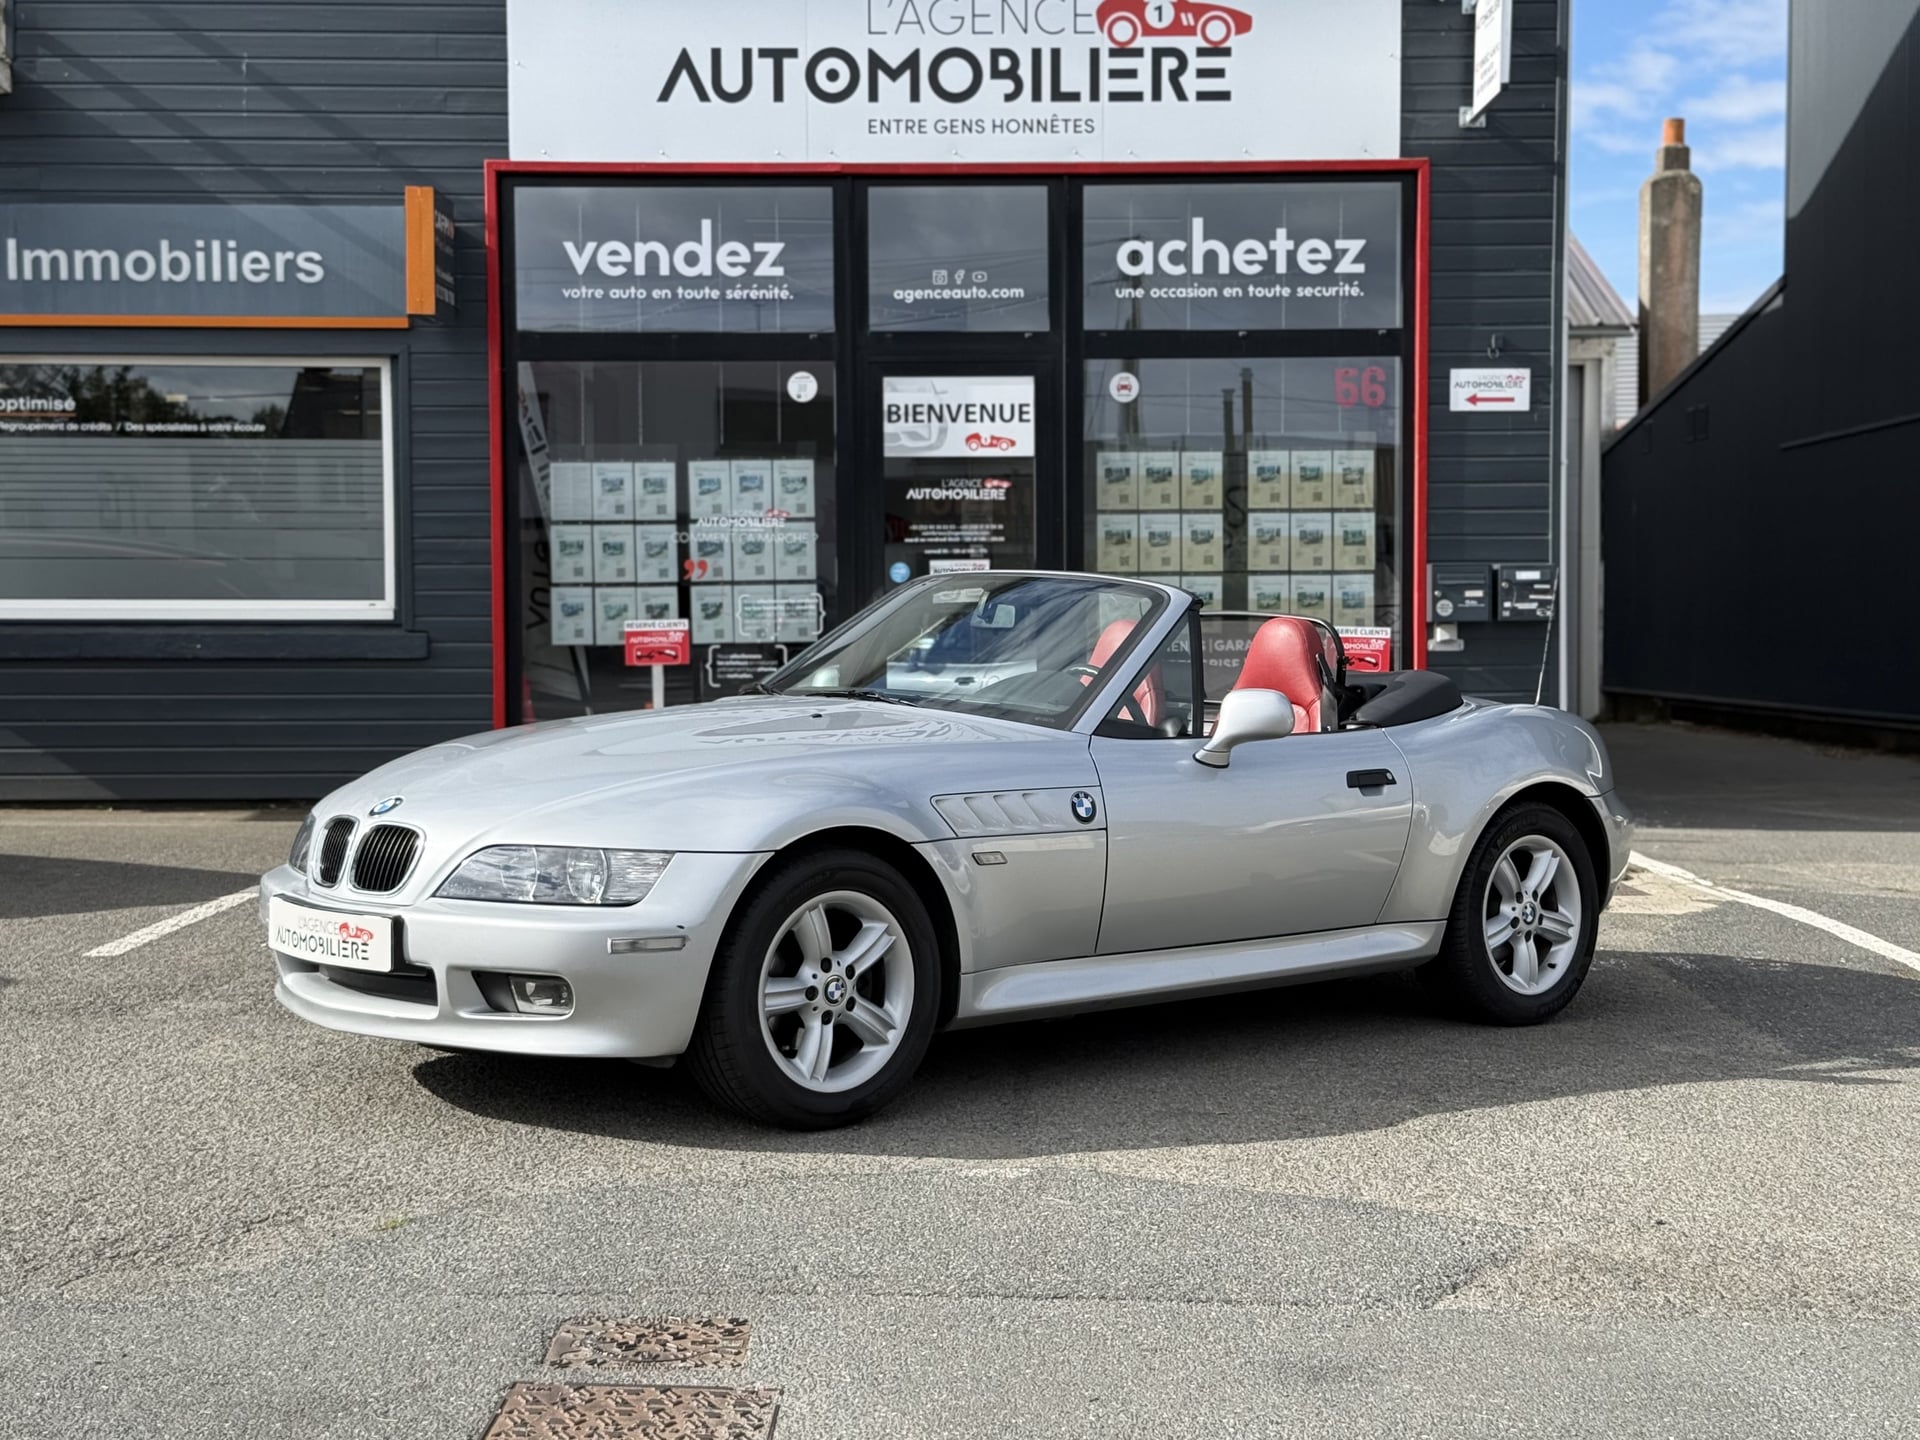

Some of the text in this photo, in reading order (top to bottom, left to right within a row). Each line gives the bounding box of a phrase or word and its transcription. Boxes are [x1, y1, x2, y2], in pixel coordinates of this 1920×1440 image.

[867, 0, 1096, 35] L'AGENCE
[867, 114, 1095, 135] ENTRE GENS HONNÊTES
[562, 218, 786, 278] vendez
[1115, 216, 1367, 276] achetez
[5, 237, 325, 283] Immobiliers
[561, 283, 795, 300] votre auto en toute sérénité.
[893, 285, 1025, 304] agenceauto.com
[1115, 281, 1365, 299] une occasion en toute securité.
[886, 402, 1032, 424] BIENVENUE
